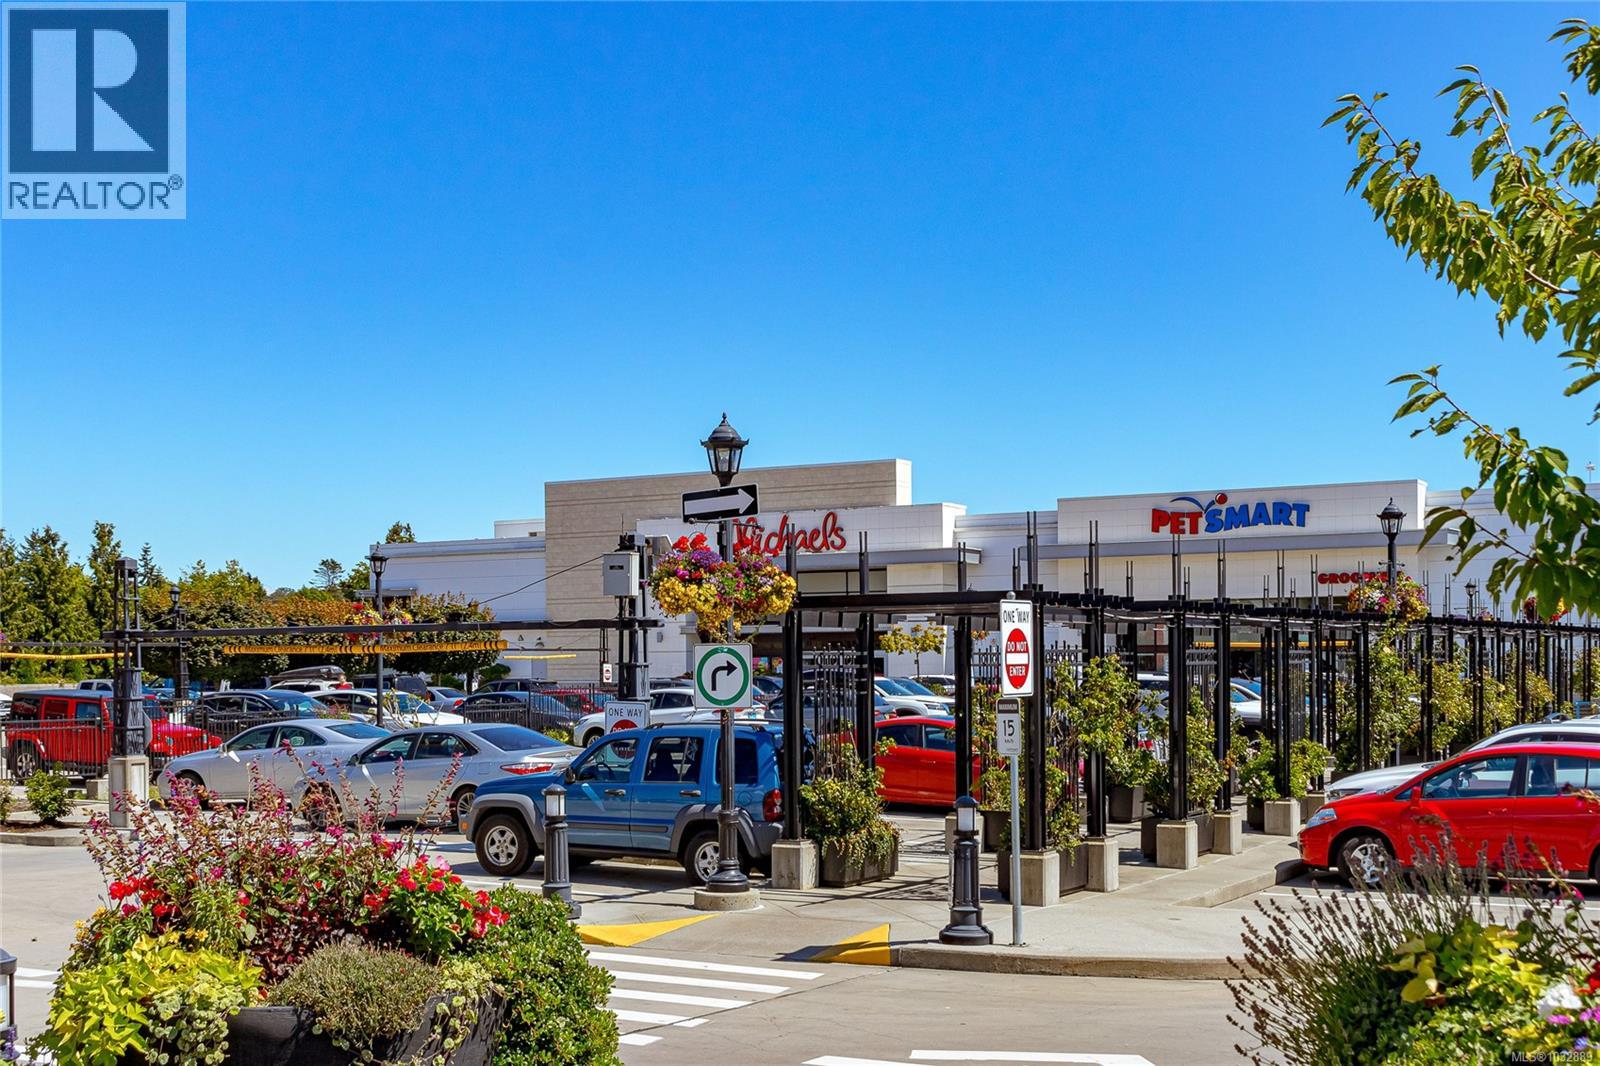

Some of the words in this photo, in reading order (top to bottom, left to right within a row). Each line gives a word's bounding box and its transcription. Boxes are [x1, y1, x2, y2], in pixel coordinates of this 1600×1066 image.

[1003, 610, 1015, 623] ONE
[1017, 610, 1030, 623] WAY
[1007, 641, 1015, 652] DO
[1016, 641, 1027, 652] NOT
[1009, 666, 1026, 676] ENTER
[608, 707, 624, 717] ONE
[626, 708, 643, 717] WAY
[1003, 719, 1015, 737] 15
